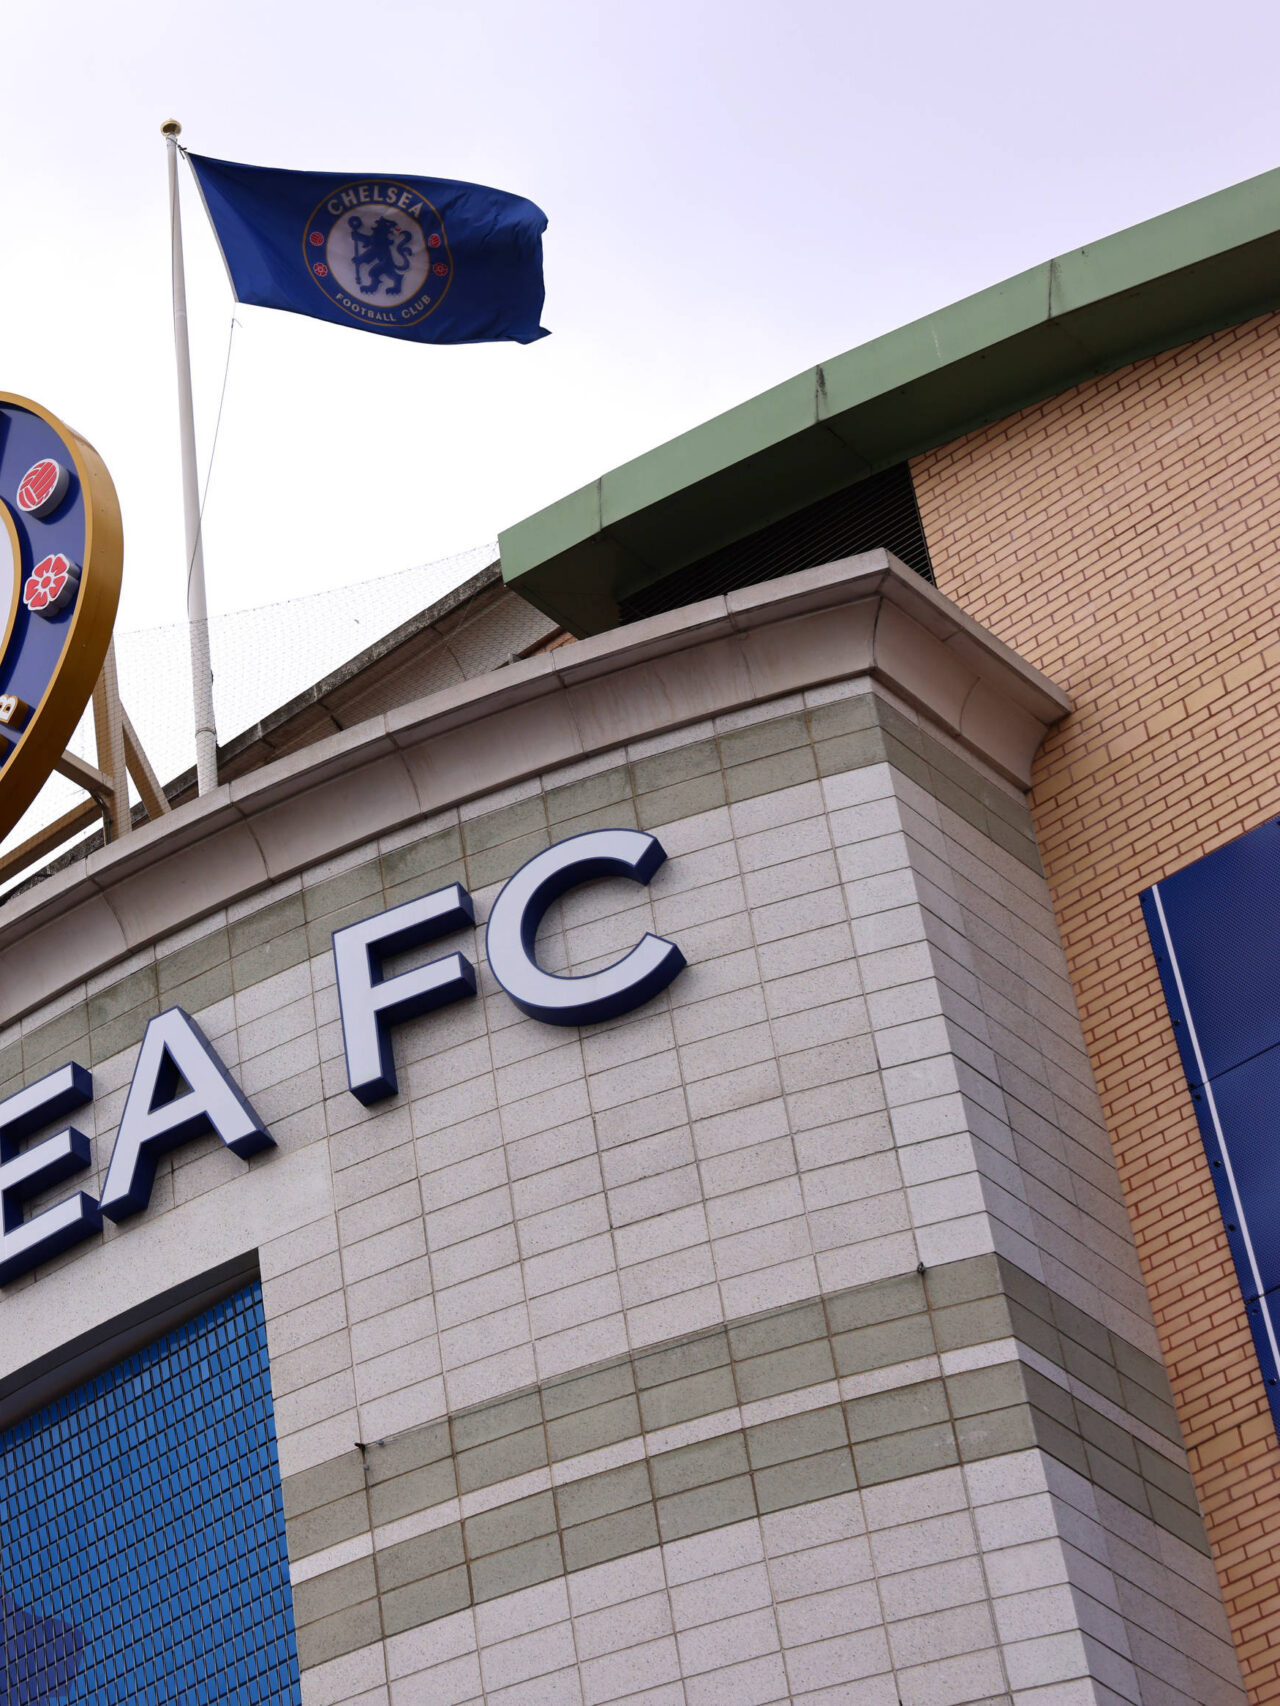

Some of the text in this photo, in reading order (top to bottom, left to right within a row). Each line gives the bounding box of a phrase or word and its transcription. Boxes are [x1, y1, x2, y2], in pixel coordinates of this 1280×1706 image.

[327, 185, 425, 219] CHELSEA
[334, 292, 432, 322] FOOTBALL CLUB
[331, 827, 688, 1107] FC
